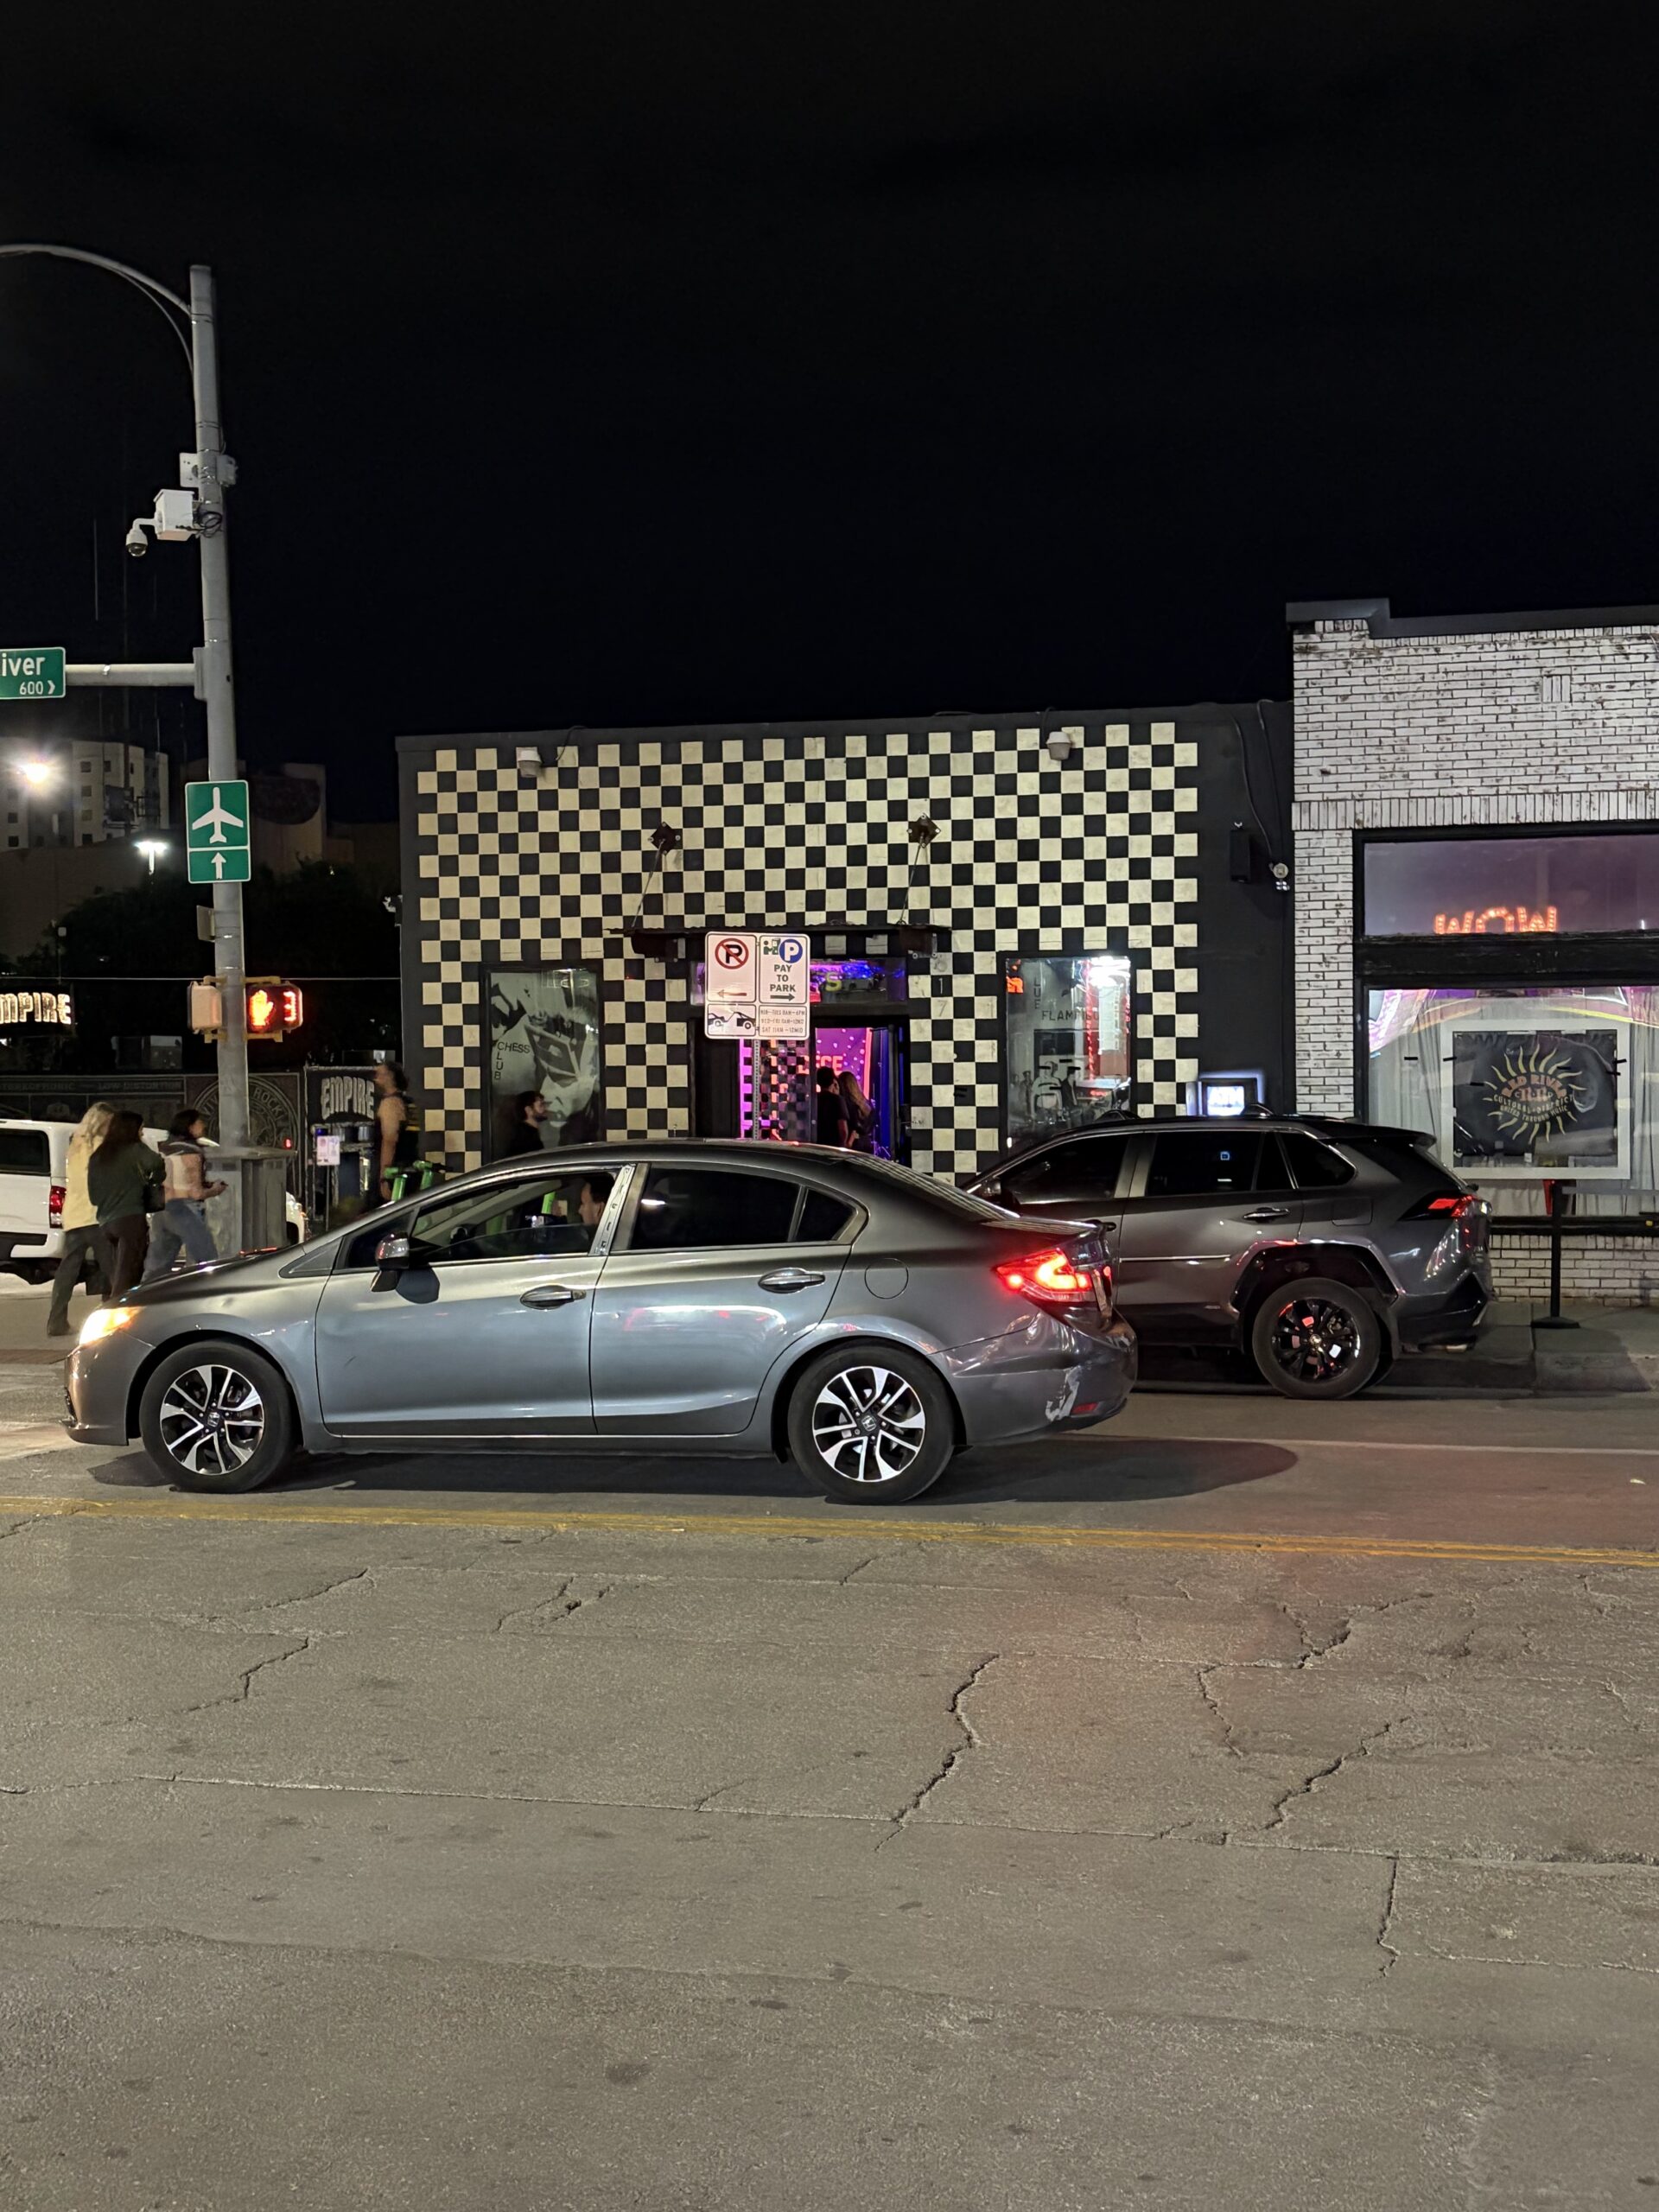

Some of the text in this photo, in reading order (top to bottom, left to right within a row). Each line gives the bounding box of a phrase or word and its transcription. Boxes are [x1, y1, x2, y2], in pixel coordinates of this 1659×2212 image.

[2, 652, 46, 677] iver
[19, 681, 44, 695] 600
[725, 944, 743, 963] P
[784, 942, 799, 961] P
[0, 992, 72, 1025] MPIRE
[283, 990, 296, 1021] 3
[497, 1041, 531, 1054] CHESS
[1501, 1074, 1567, 1099] RED RIVER
[321, 1076, 375, 1120] EMPIRE
[1550, 1105, 1568, 1116] MUSIC
